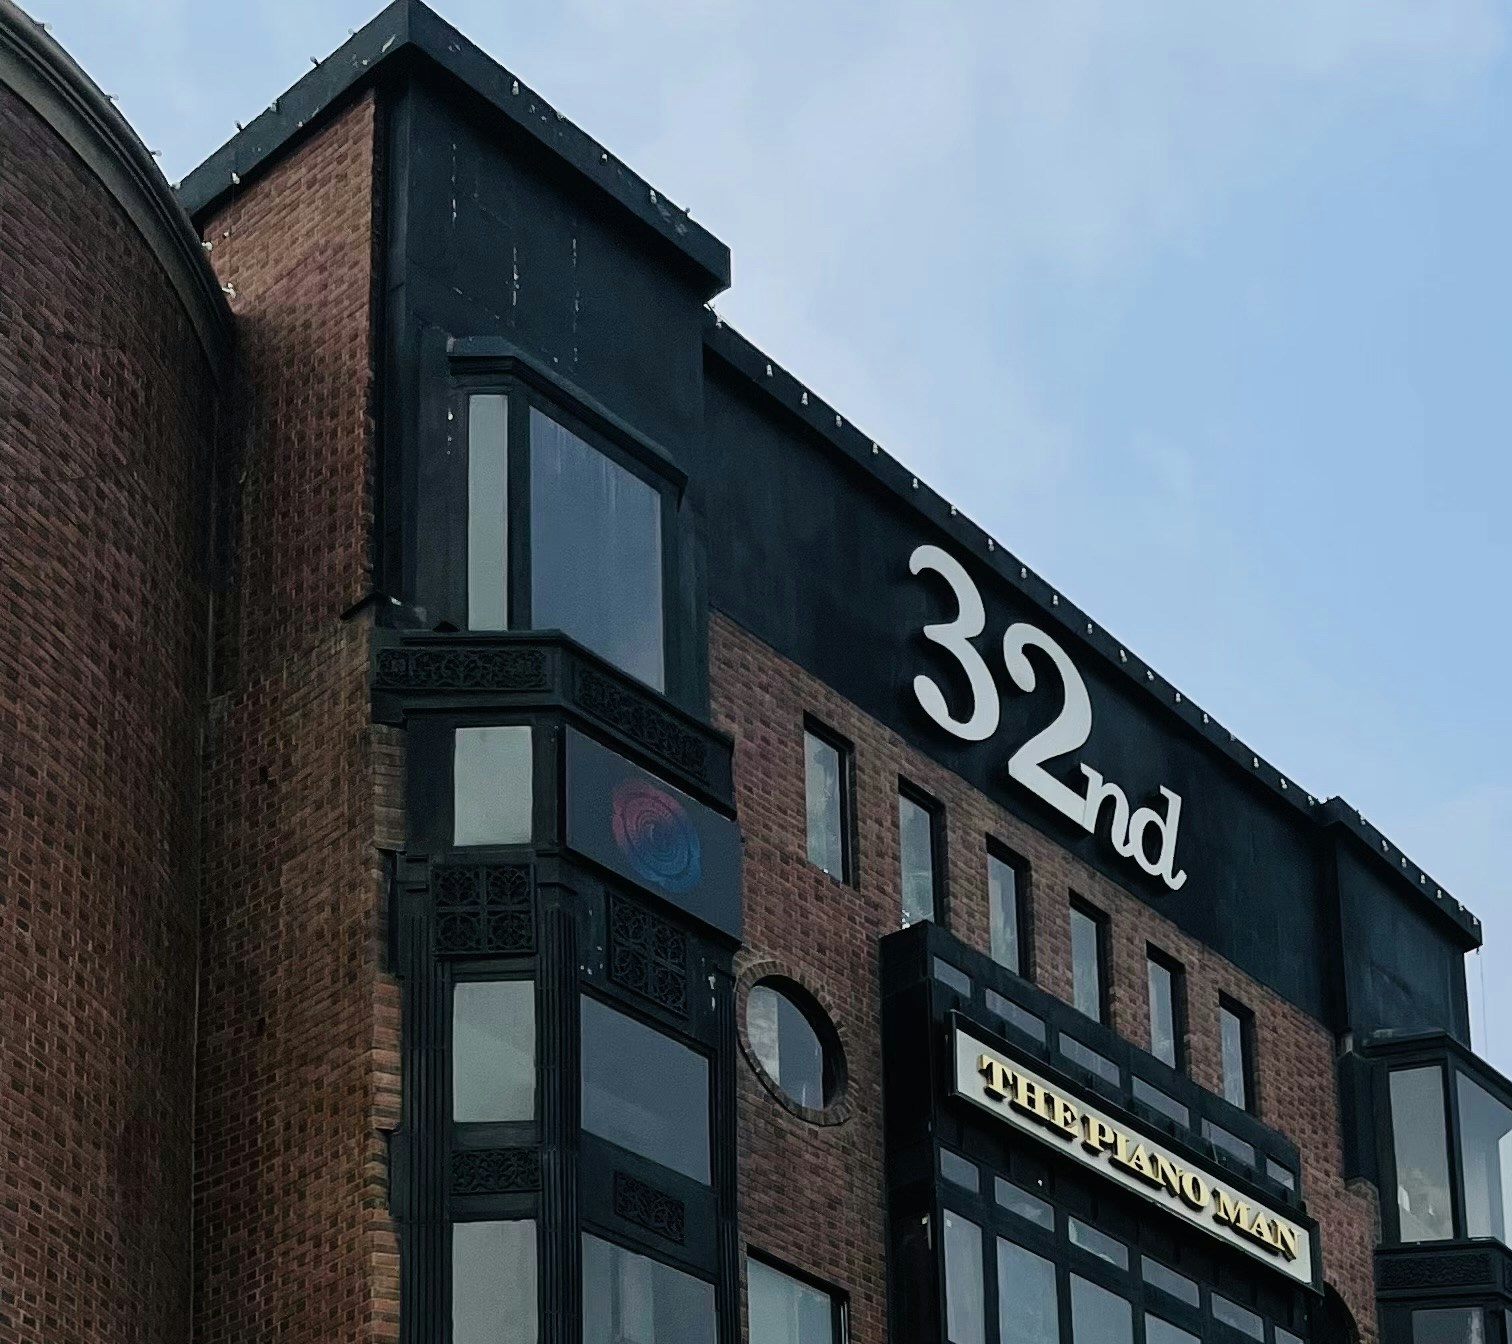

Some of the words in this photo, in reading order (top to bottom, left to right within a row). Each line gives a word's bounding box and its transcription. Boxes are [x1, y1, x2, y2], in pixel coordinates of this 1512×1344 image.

[909, 544, 1188, 891] 32nd
[979, 1052, 1080, 1131] THE
[1085, 1116, 1209, 1207] PIANO
[1214, 1183, 1301, 1261] MAN
